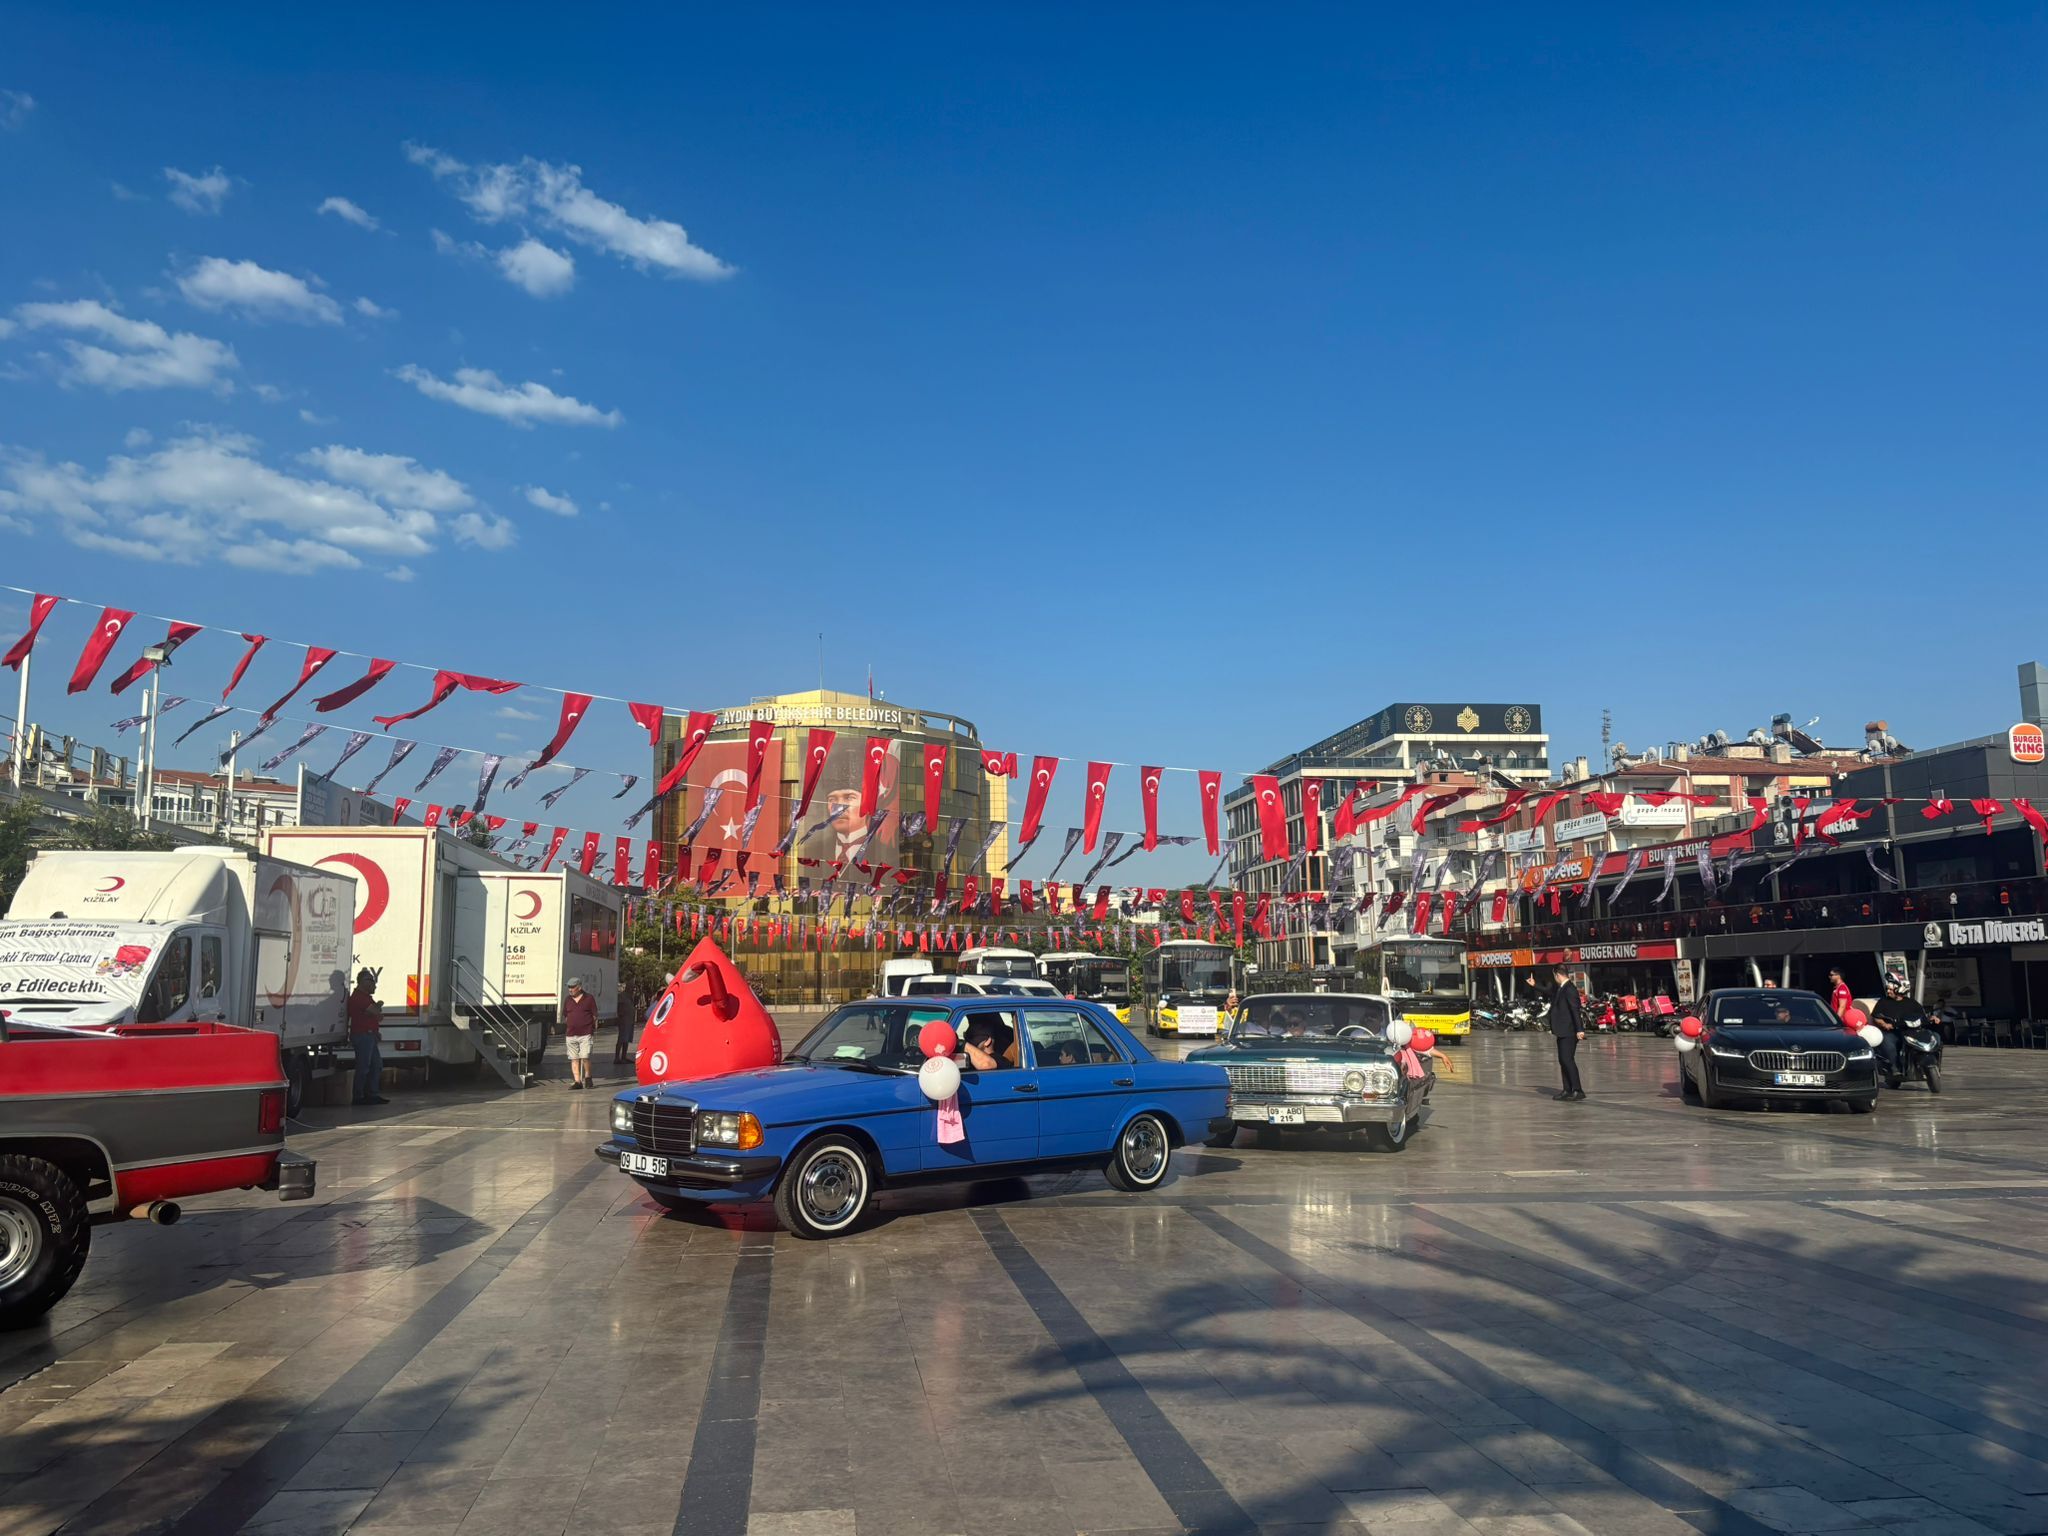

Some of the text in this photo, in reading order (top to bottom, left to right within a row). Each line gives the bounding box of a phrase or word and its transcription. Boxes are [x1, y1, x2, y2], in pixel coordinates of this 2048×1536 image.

[724, 709, 753, 724] AYDIN
[837, 706, 902, 723] BELEDİYESİ
[2014, 743, 2043, 753] KING
[19, 928, 116, 938] Bağışçılarımıza
[1949, 923, 1984, 945] USTA
[507, 945, 526, 953] 168
[1579, 944, 1638, 960] BURGER KING
[20, 951, 59, 962] Termal
[59, 952, 91, 964] Çanta
[621, 1153, 667, 1174] 09 LD 515
